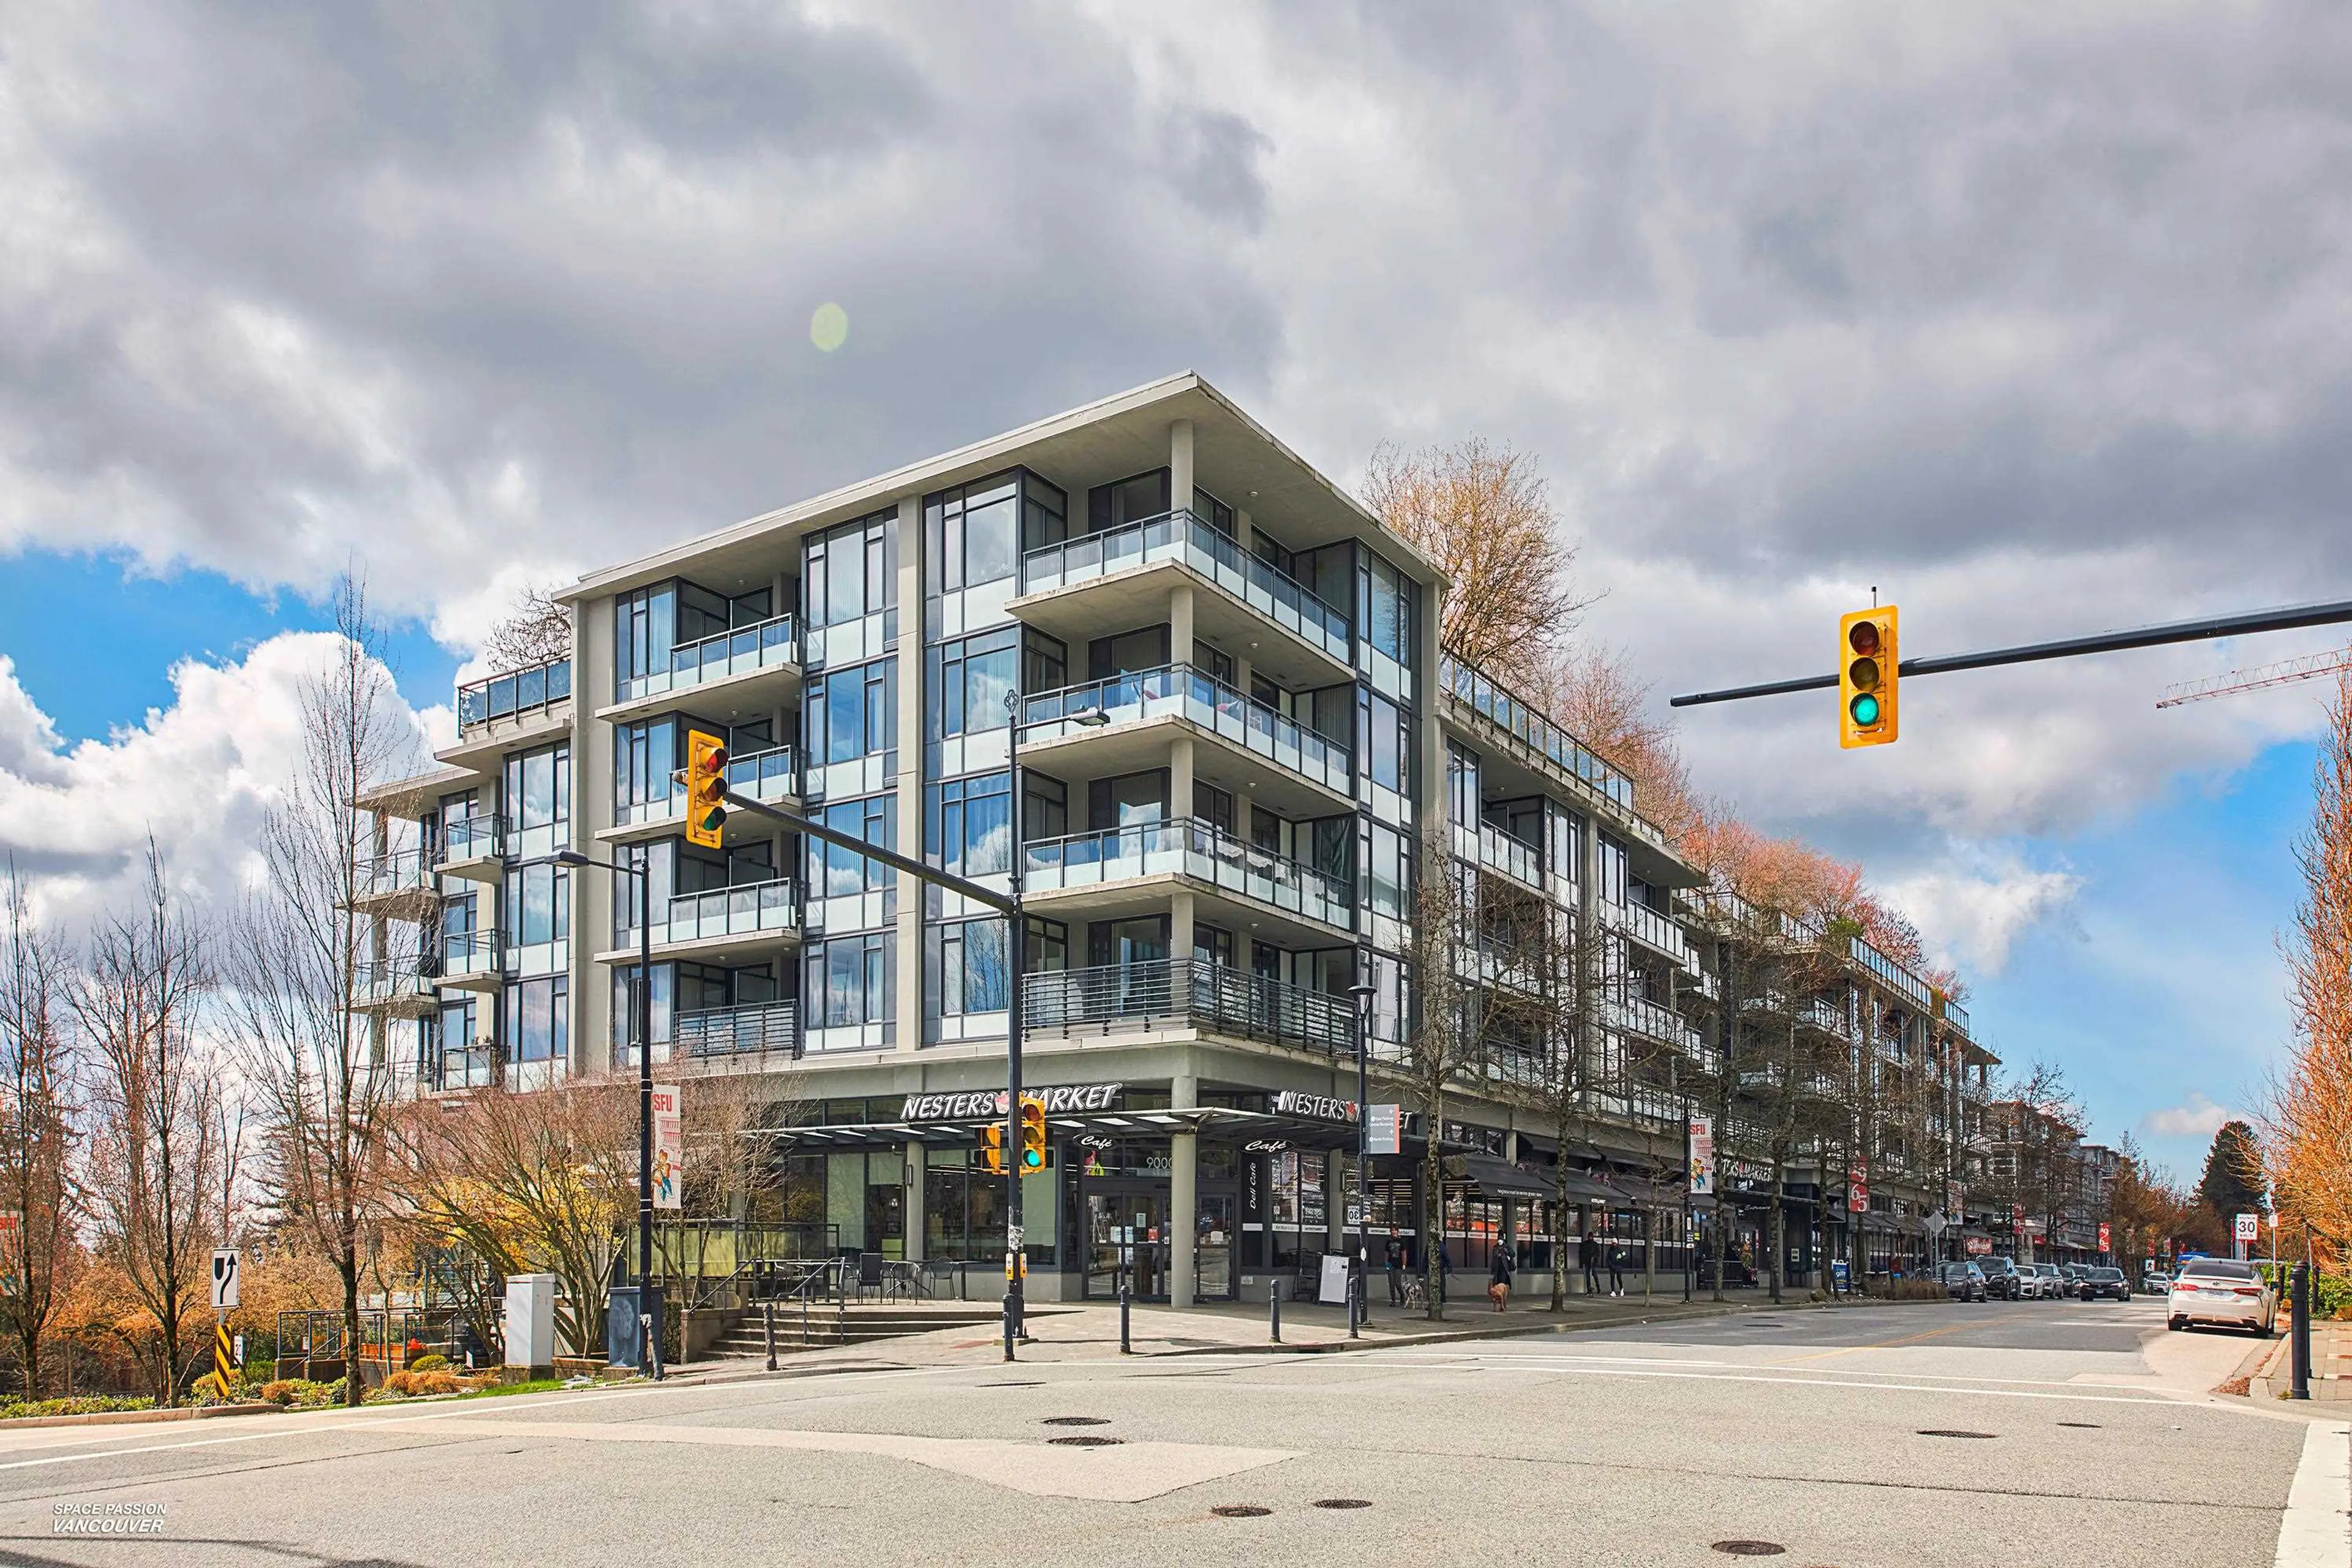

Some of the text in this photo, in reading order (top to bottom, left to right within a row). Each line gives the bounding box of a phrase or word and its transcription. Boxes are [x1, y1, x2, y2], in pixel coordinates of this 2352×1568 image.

[652, 1093, 673, 1112] SFU
[900, 1092, 995, 1120] NESTERS
[1283, 1090, 1346, 1120] NESTERS
[1690, 1124, 1706, 1135] SFU
[1080, 1136, 1113, 1150] Café
[1245, 1140, 1287, 1153] Café
[2239, 1221, 2255, 1232] 30
